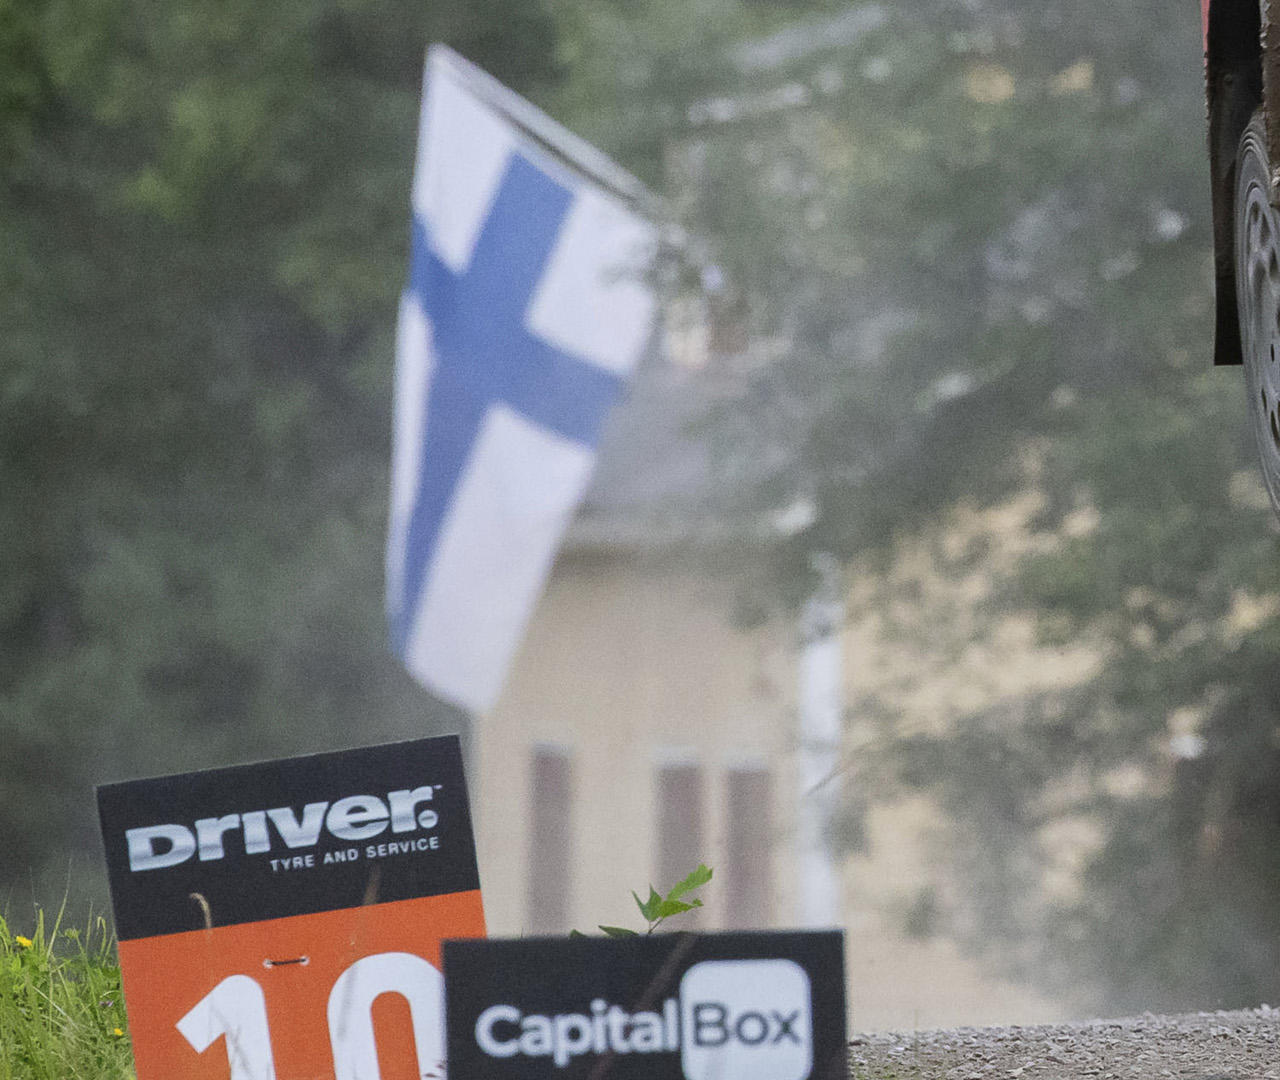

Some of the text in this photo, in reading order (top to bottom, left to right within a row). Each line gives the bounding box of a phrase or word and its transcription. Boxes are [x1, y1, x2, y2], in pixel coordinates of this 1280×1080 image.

[269, 836, 440, 872] TYRE AND SERVICE
